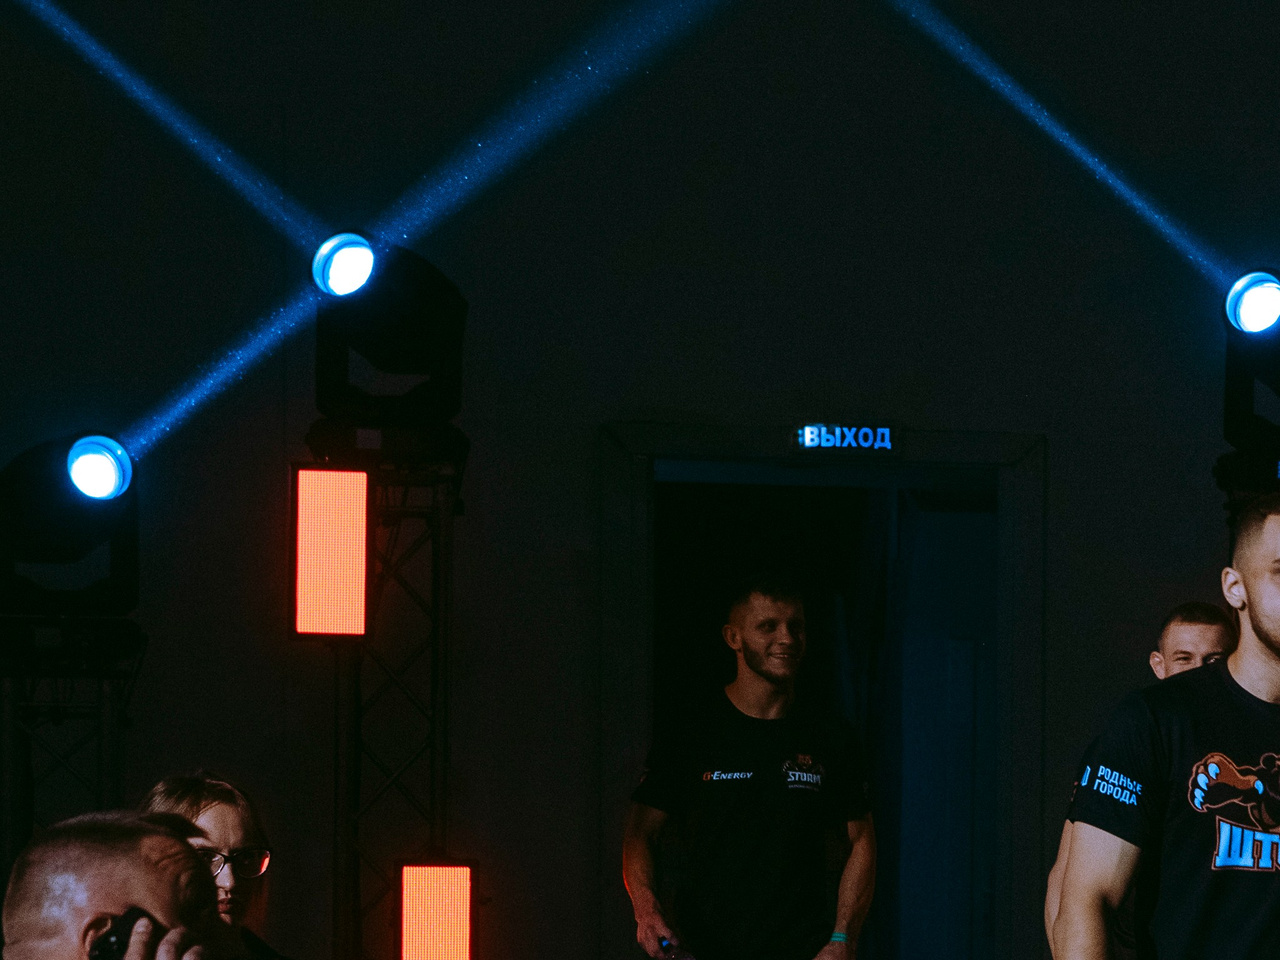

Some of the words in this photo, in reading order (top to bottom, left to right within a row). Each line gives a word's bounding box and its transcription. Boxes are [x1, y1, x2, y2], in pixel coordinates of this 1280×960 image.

[804, 426, 892, 449] ВЫХОД
[787, 770, 821, 785] STORM
[1097, 765, 1143, 795] РОДНЫЕ
[1093, 779, 1137, 805] ГОРОДА
